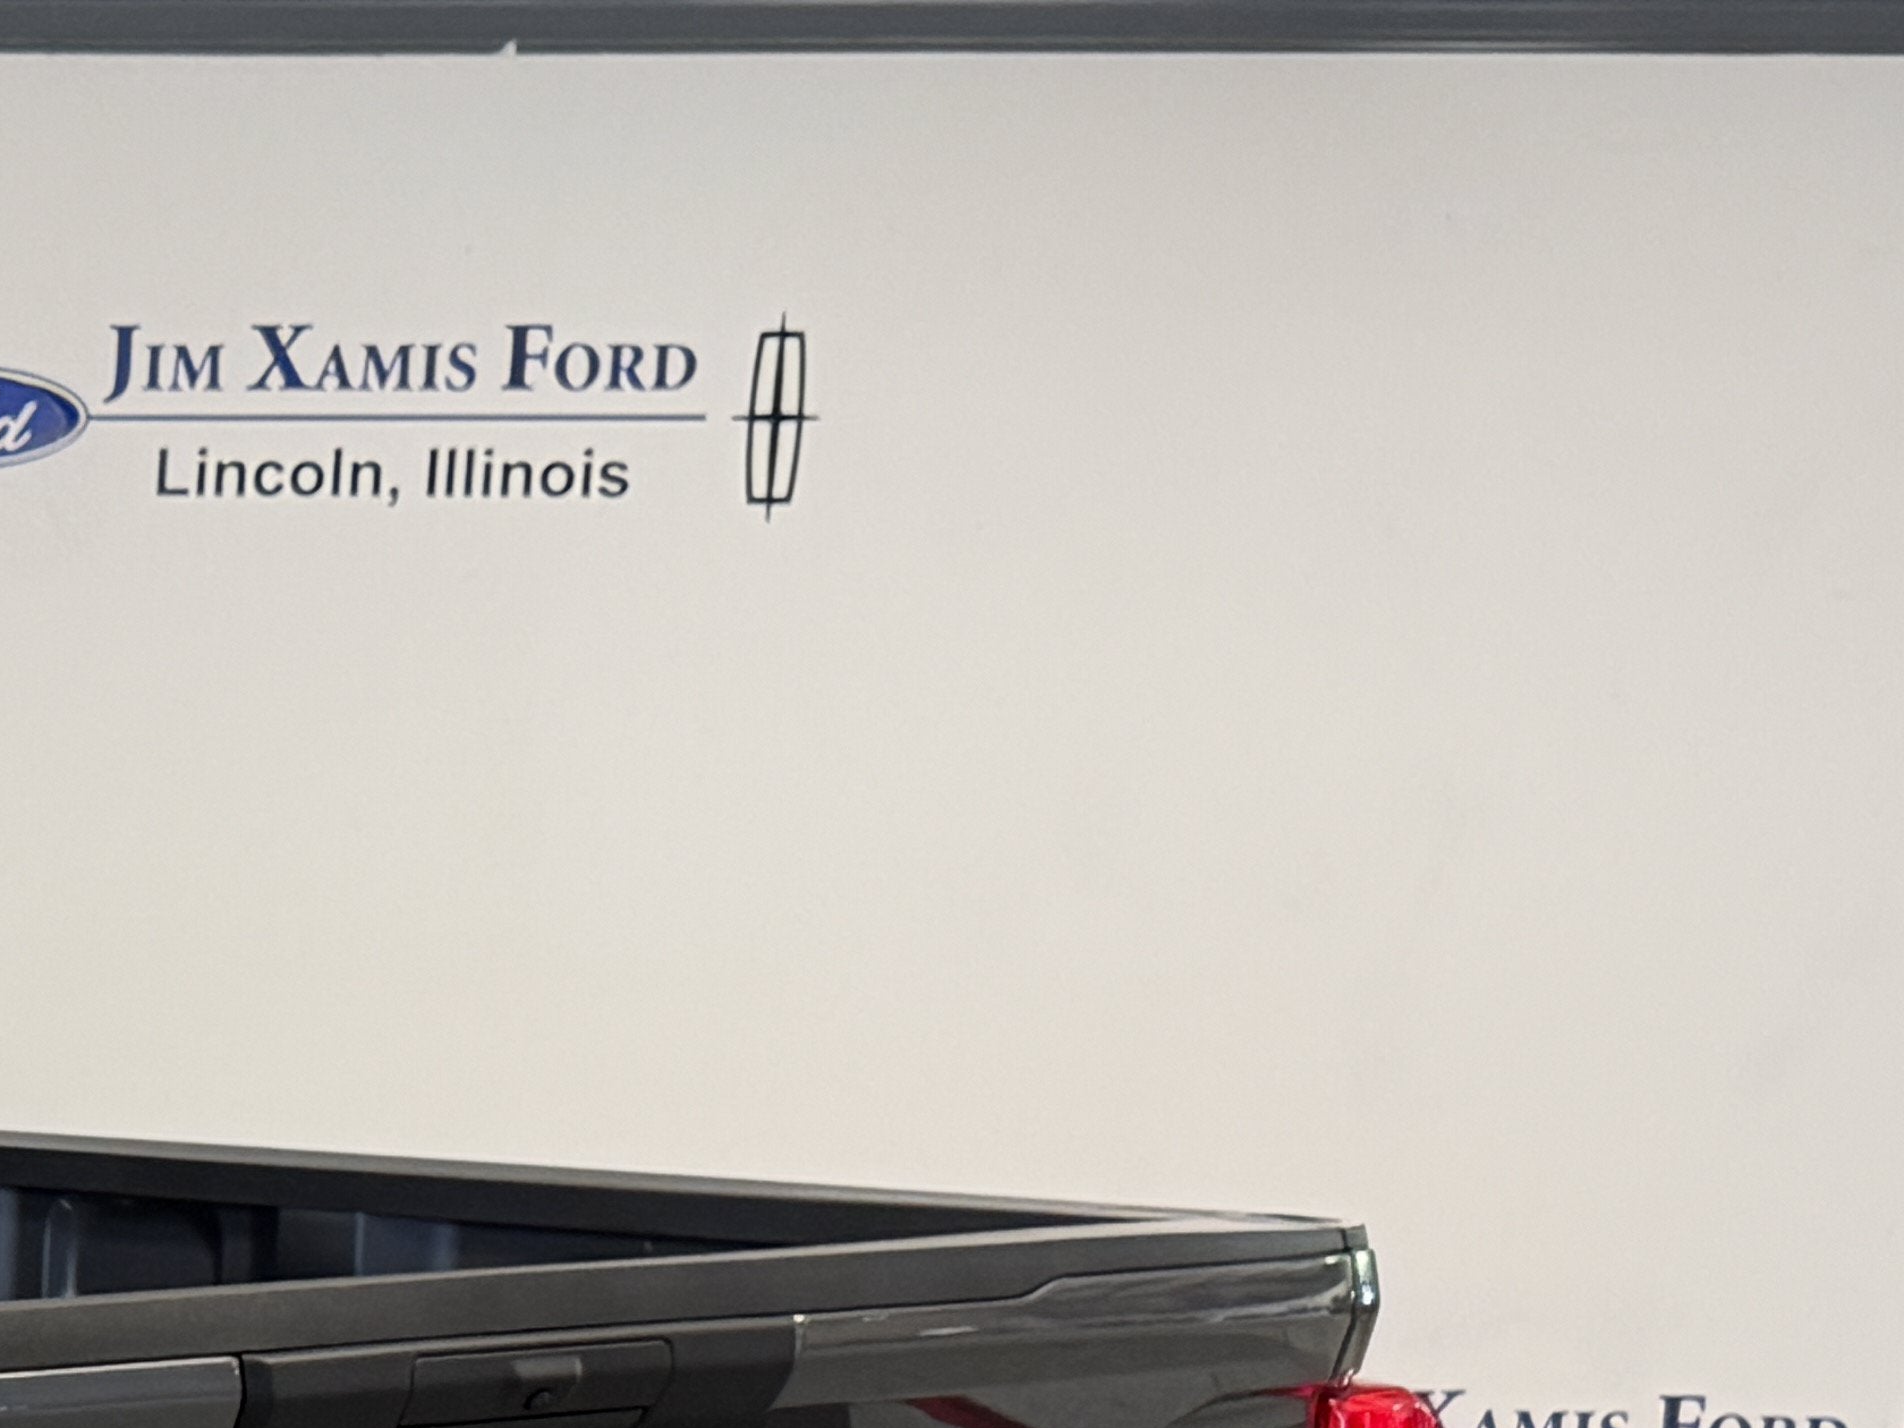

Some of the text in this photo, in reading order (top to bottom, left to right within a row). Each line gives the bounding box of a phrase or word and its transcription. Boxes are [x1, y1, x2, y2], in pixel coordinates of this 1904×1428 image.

[103, 323, 699, 403] JIM XAMIS FORD
[156, 447, 630, 507] Lincoln, Illinois
